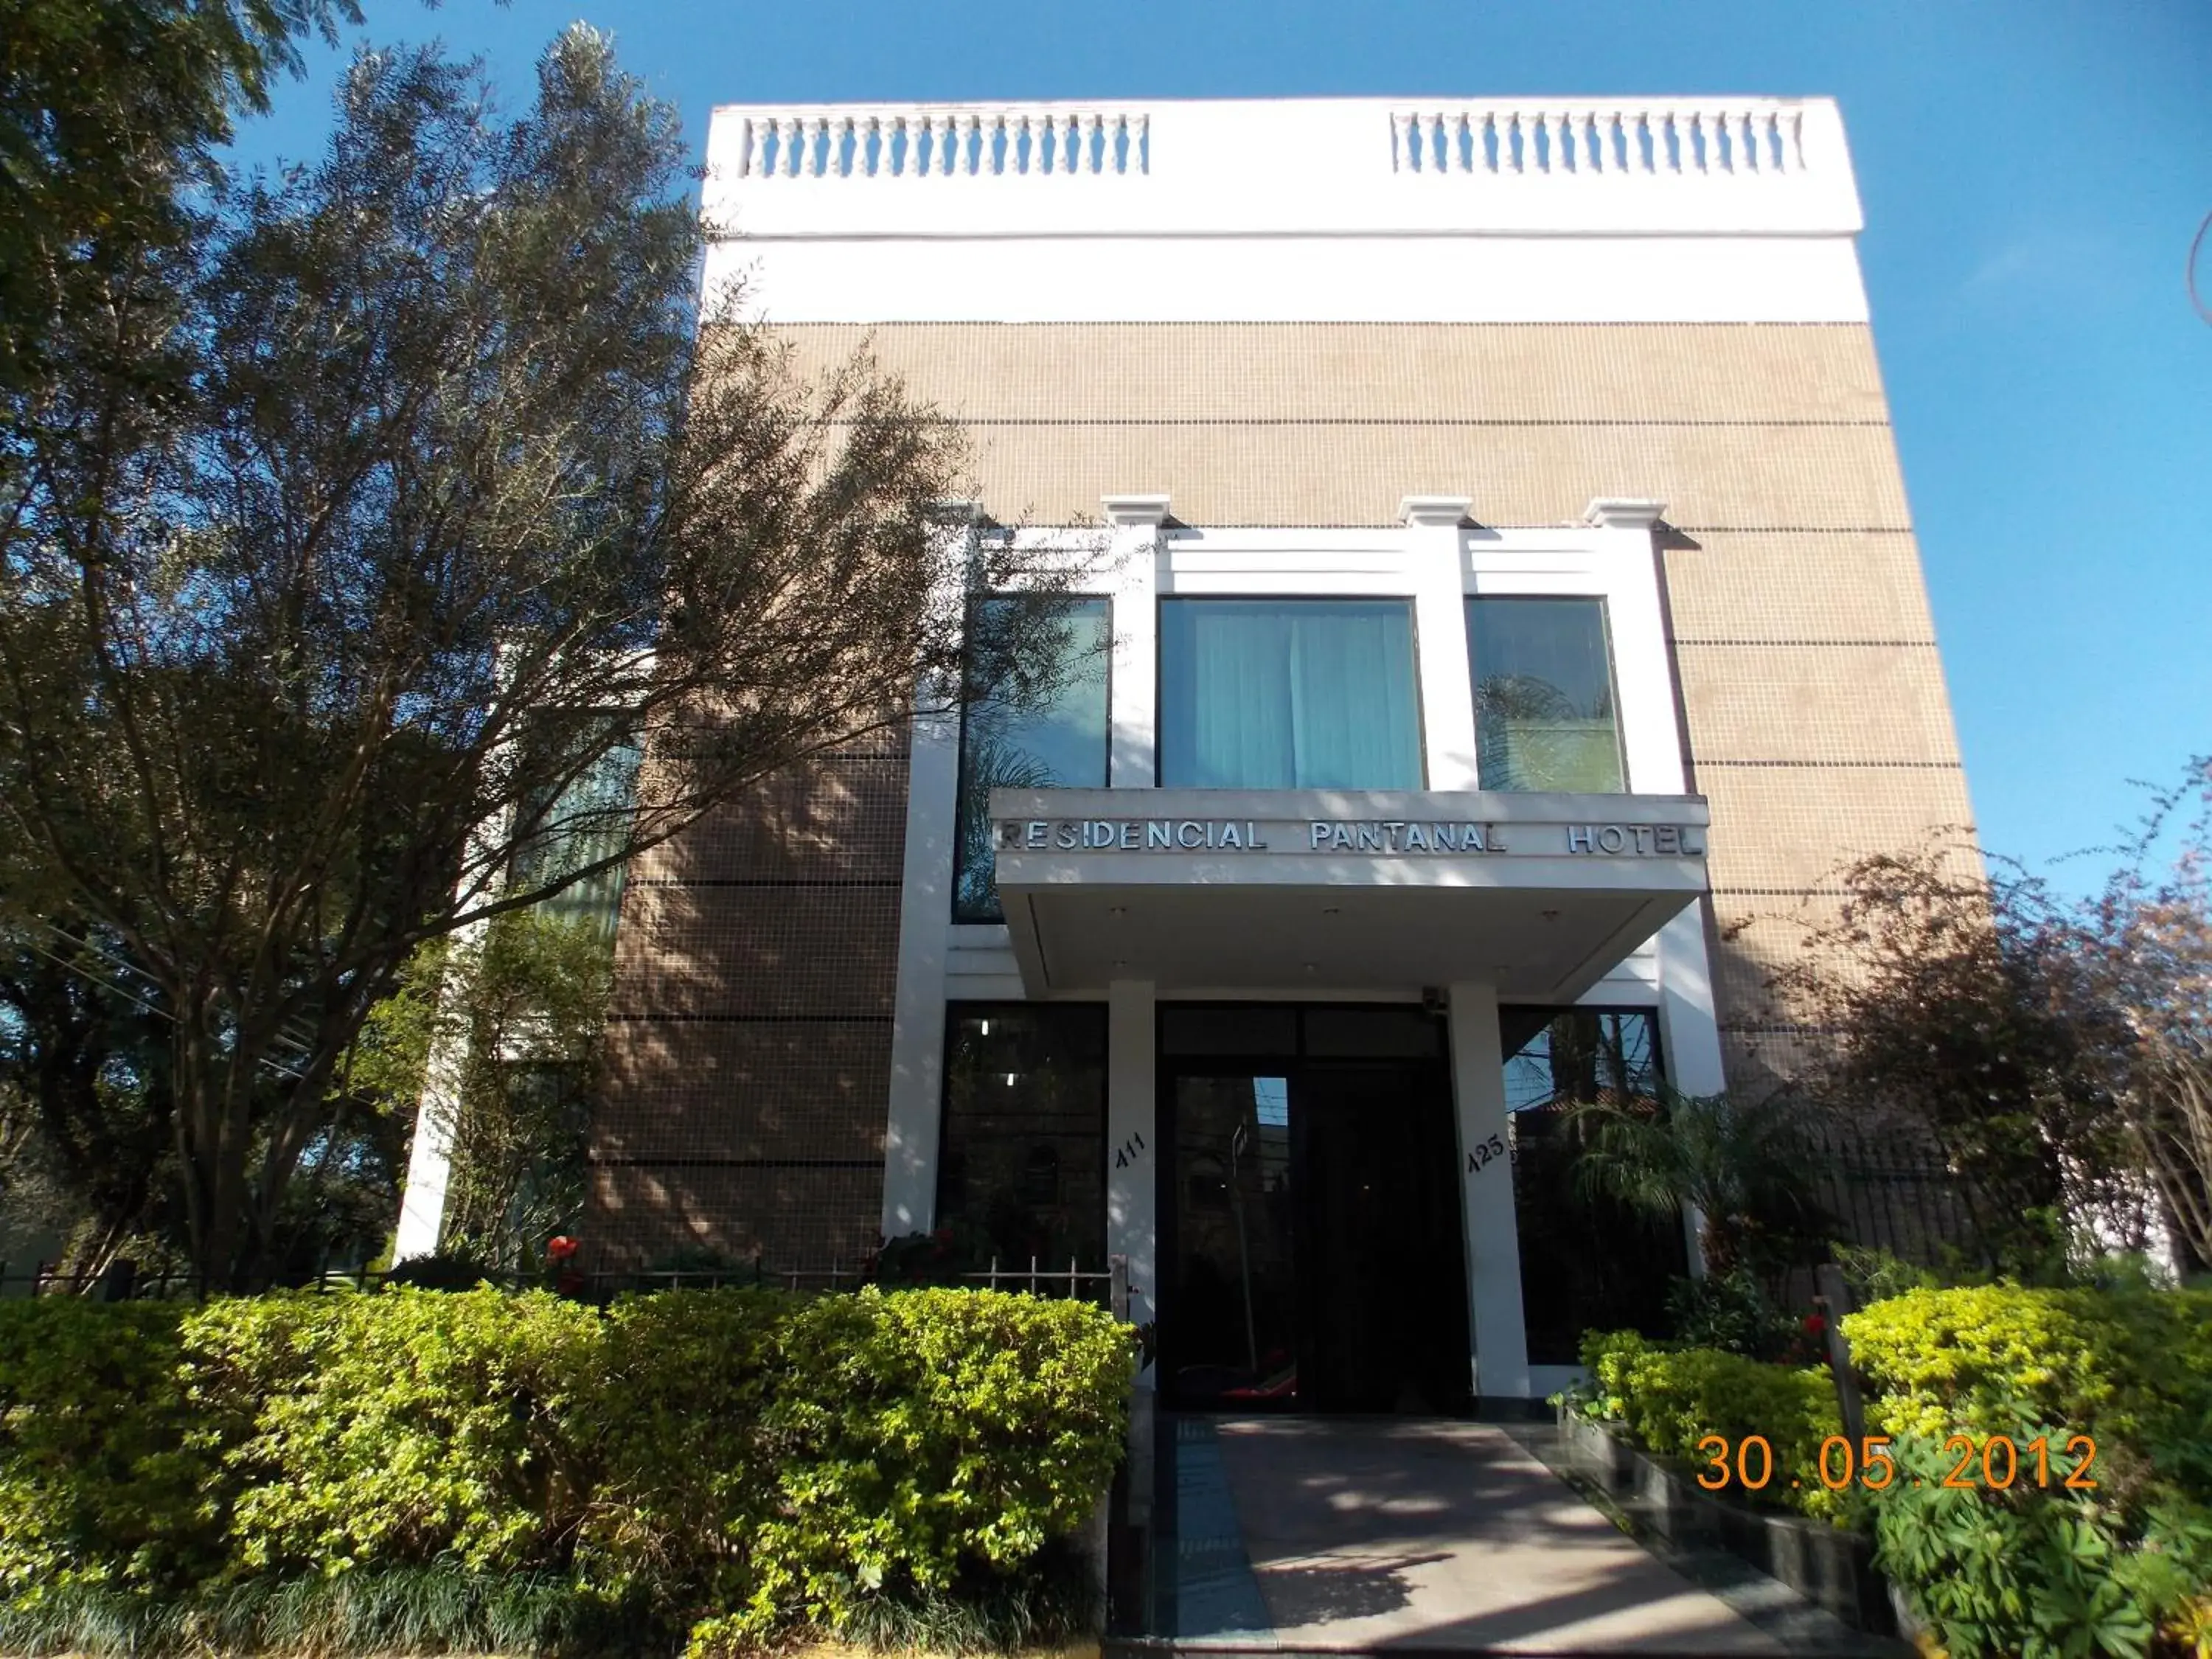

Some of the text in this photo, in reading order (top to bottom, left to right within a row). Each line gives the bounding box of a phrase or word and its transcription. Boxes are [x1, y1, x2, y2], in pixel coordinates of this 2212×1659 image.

[999, 819, 1703, 855] RESIDENCIAL PANTANAL HOTEL
[1116, 1131, 1145, 1169] 411
